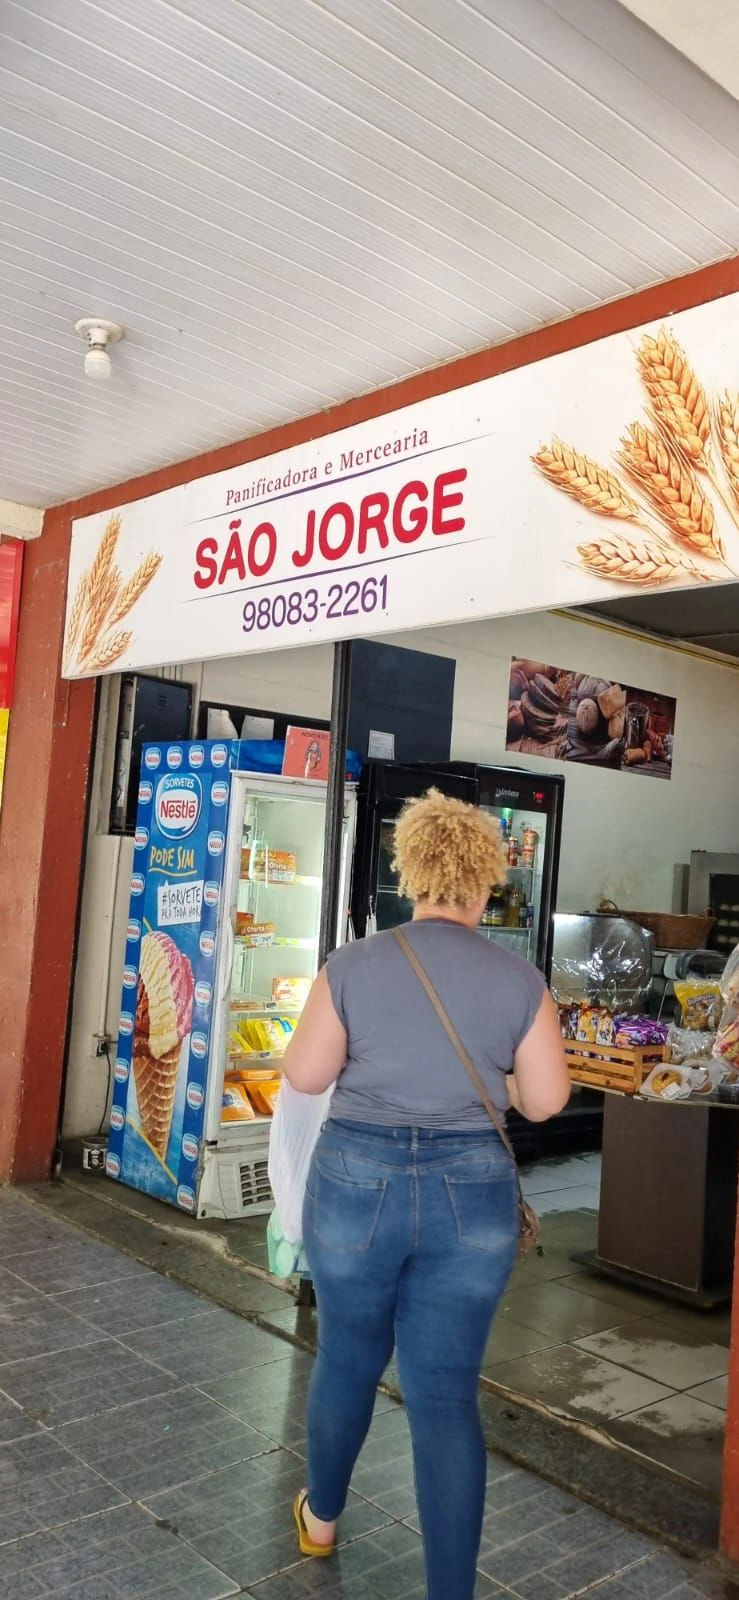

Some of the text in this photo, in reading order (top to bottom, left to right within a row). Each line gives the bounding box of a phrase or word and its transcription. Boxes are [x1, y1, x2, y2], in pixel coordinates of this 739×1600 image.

[225, 427, 429, 506] Panificadora e Mercearia
[193, 467, 468, 589] SÃO JORGE
[242, 573, 388, 633] 98083-2261
[165, 777, 195, 789] SORVETES
[150, 846, 195, 869] PODE SIM
